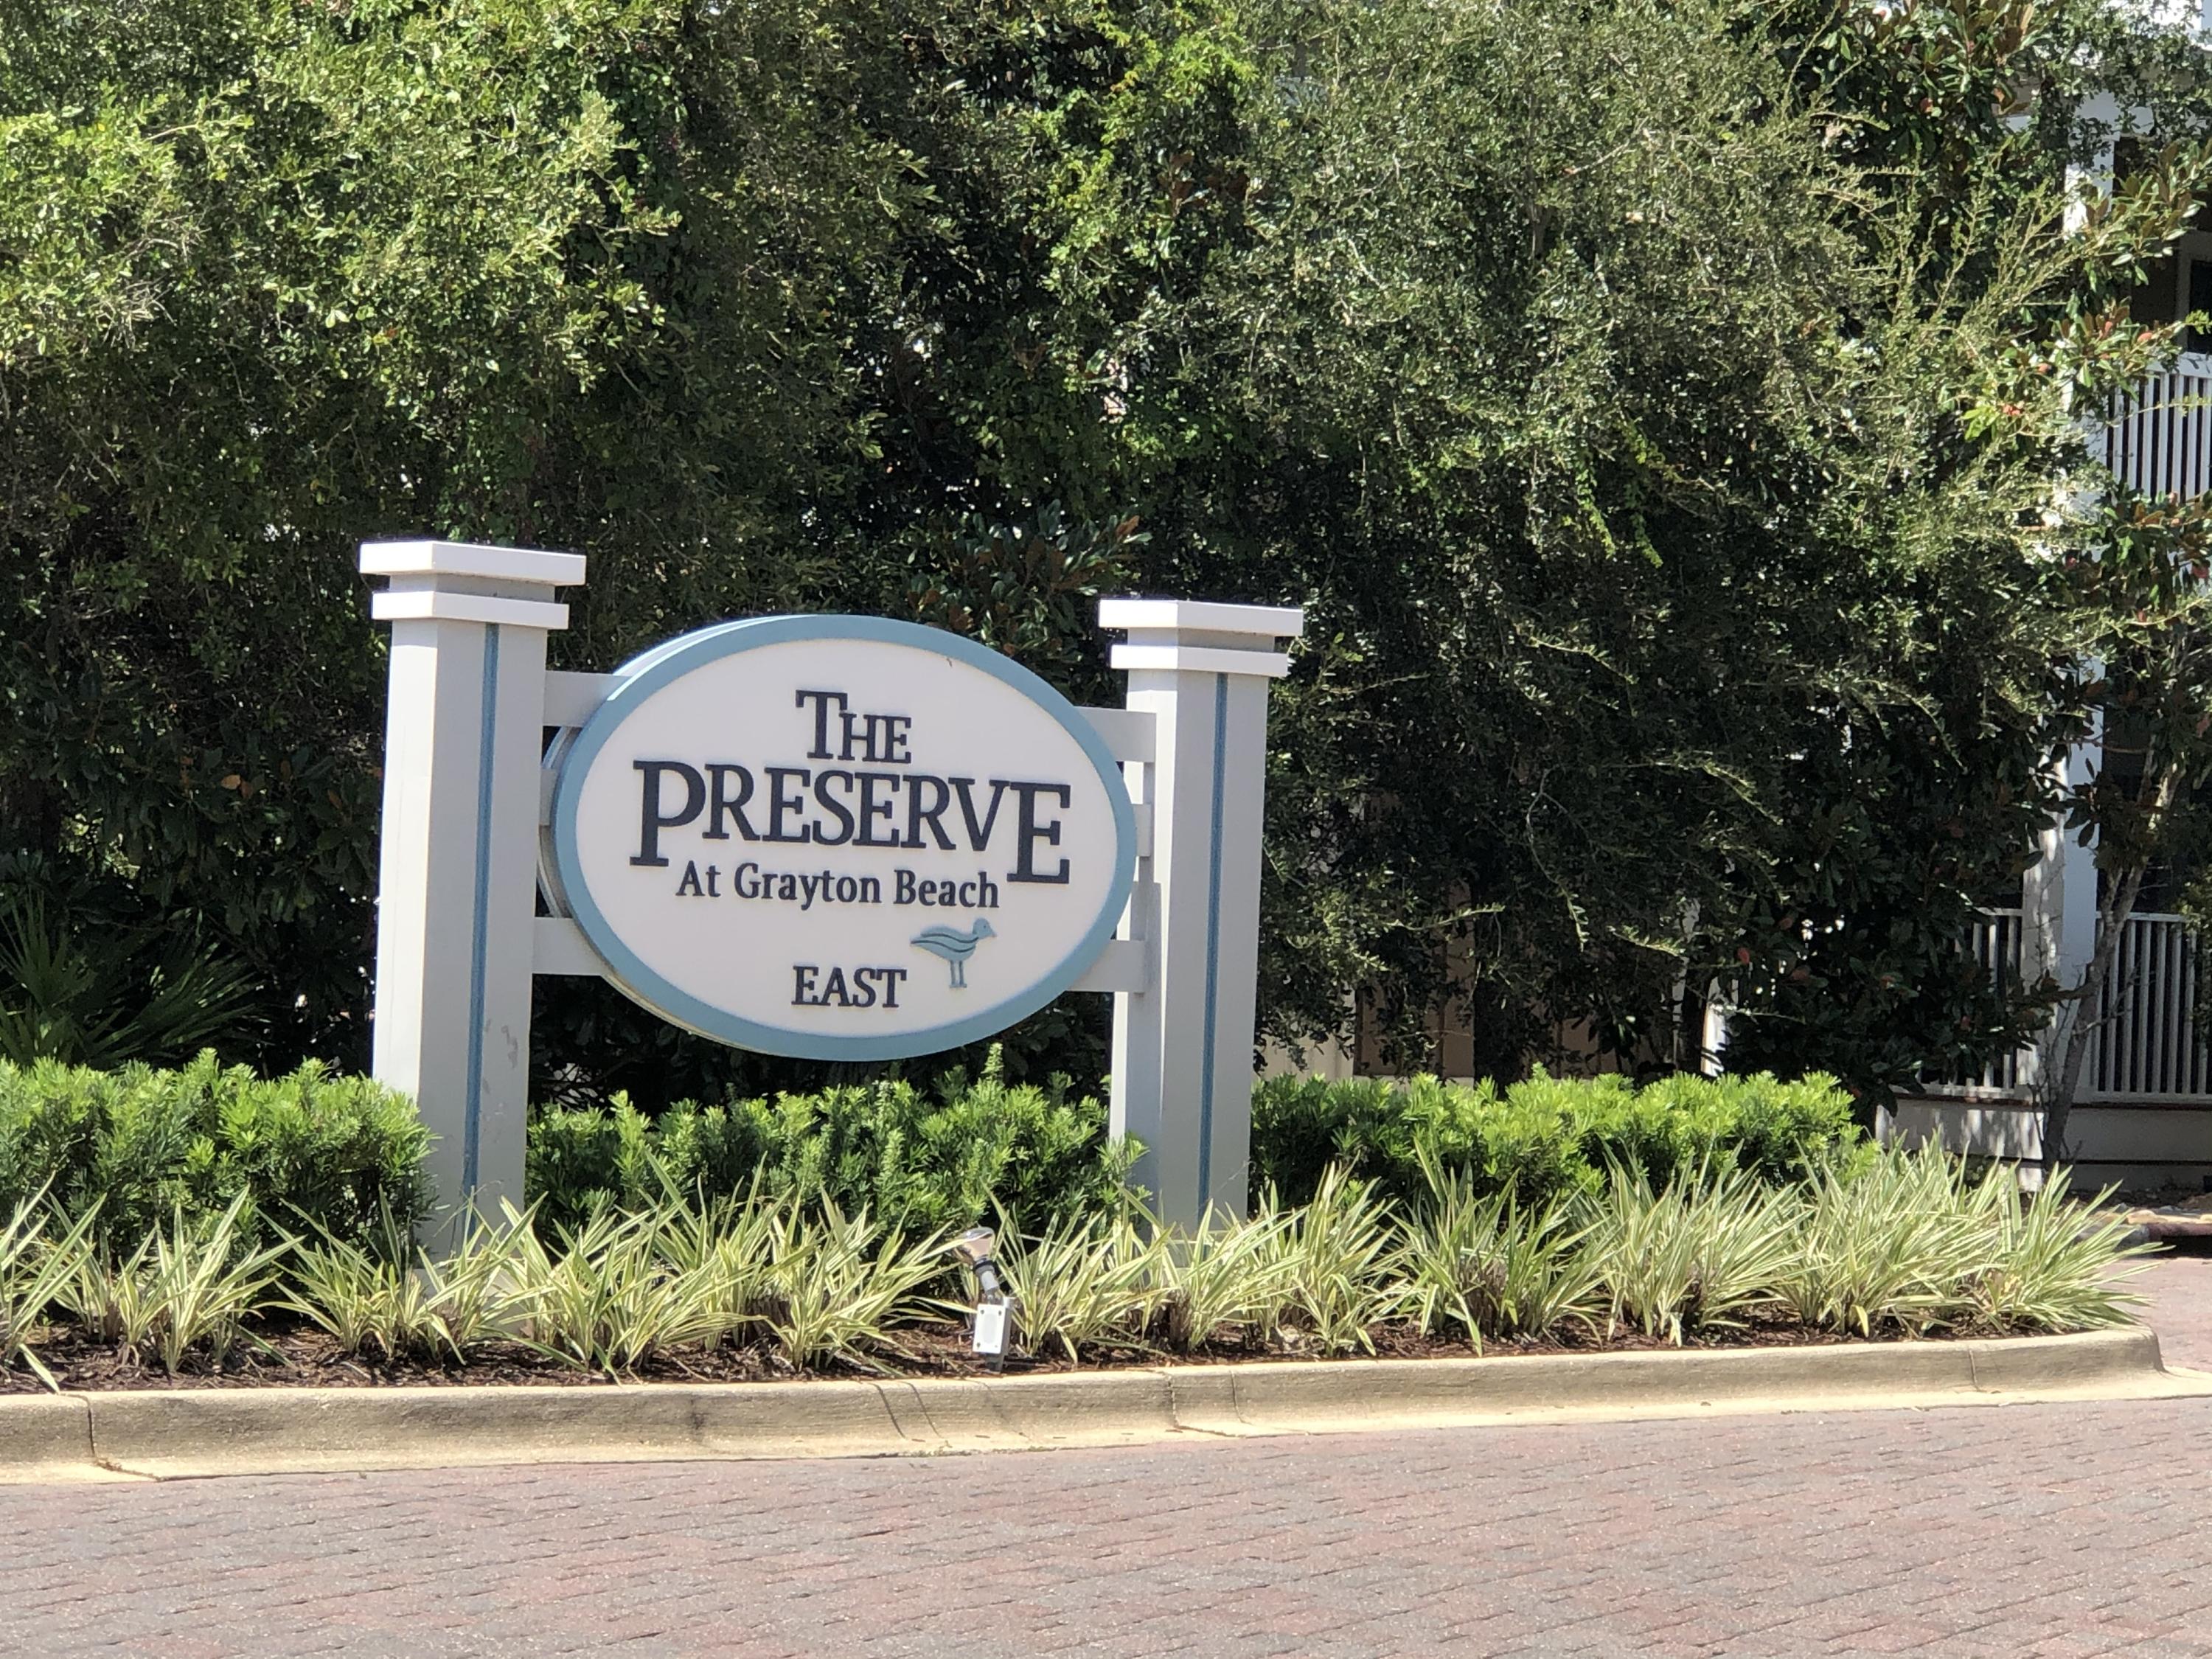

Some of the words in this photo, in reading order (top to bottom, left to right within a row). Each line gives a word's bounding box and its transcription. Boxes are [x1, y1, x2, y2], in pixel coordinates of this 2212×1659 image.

[795, 689, 912, 765] THE
[629, 759, 1071, 885] PRESERVE
[675, 860, 721, 898] At
[734, 862, 883, 911] Grayton
[892, 869, 1000, 908] Beach
[790, 964, 908, 1009] EAST
